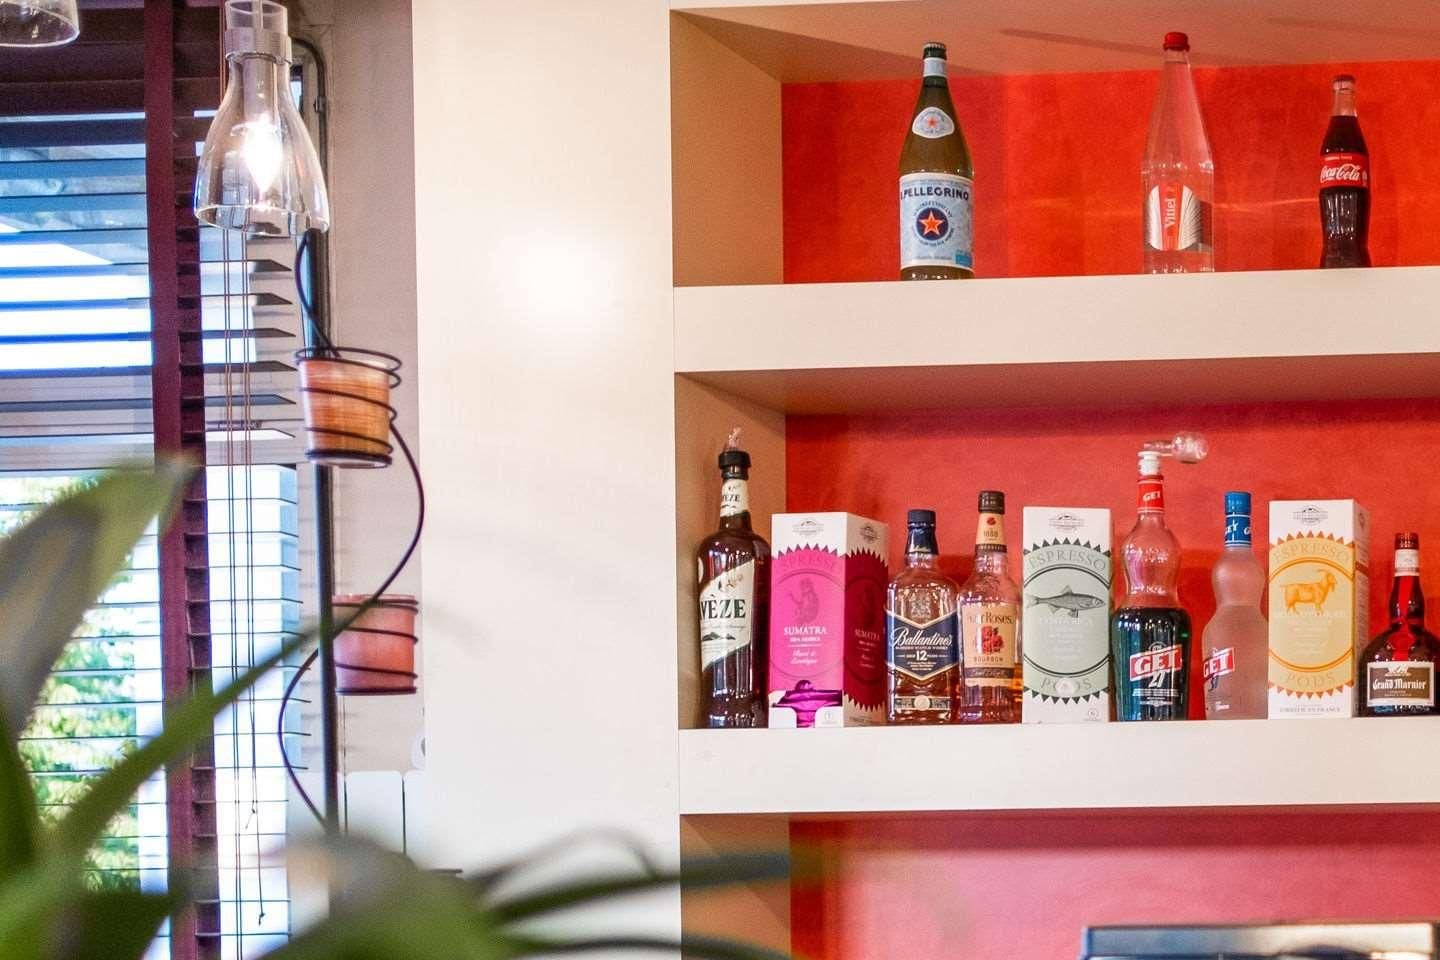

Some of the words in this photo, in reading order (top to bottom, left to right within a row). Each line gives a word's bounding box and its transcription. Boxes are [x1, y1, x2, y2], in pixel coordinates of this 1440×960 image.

[1320, 163, 1361, 183] Coca-Cola
[1029, 549, 1107, 572] ESPRESSO
[783, 625, 828, 636] SUMATRA
[890, 626, 954, 647] Ballantine's
[916, 650, 928, 661] 12
[1133, 650, 1177, 675] GET
[1394, 678, 1427, 690] Marnier
